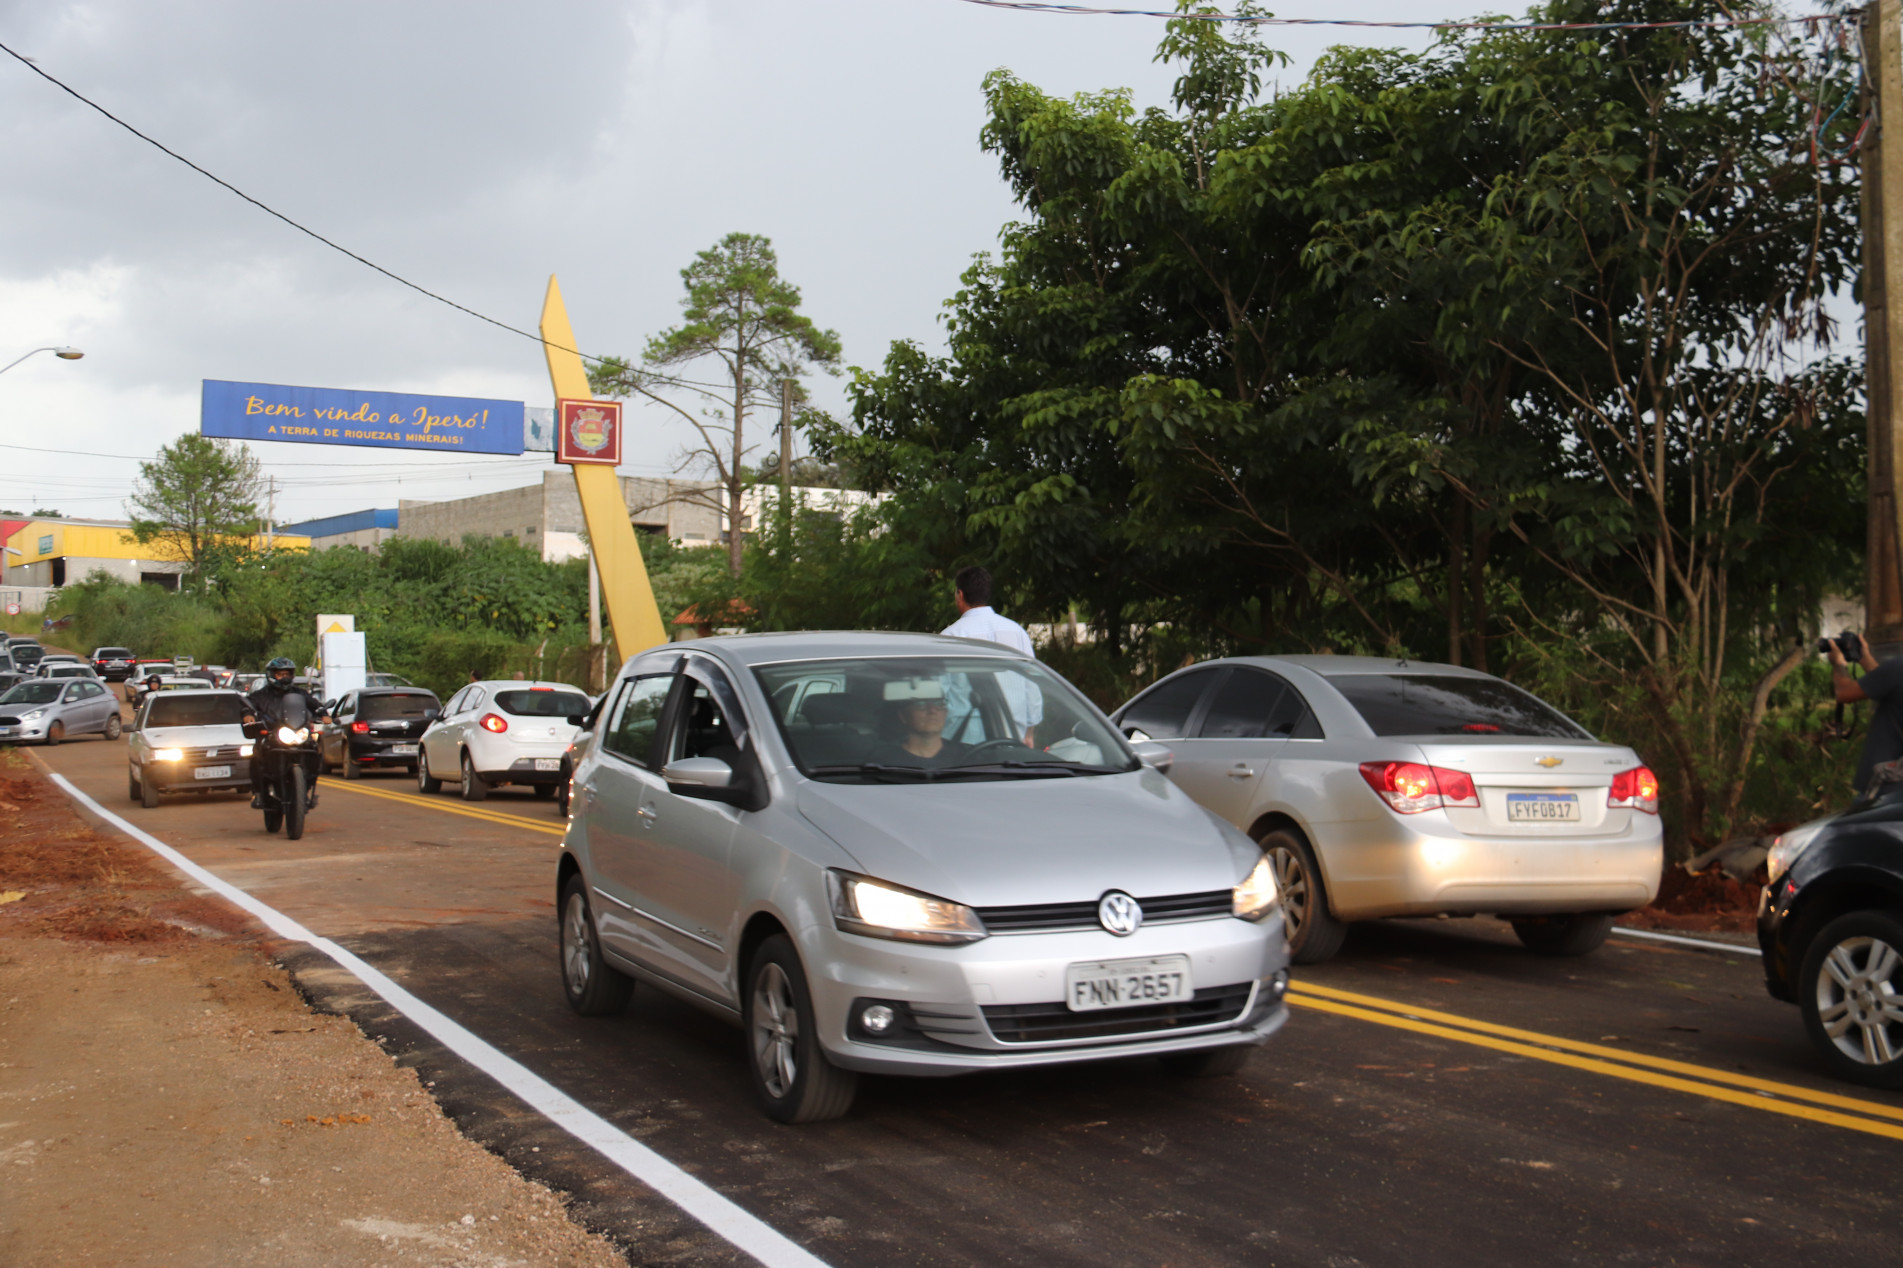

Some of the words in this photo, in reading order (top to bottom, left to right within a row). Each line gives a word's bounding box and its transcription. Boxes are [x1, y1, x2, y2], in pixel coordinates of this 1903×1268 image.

[245, 395, 306, 418] Bem
[313, 402, 380, 423] vindo
[388, 413, 406, 424] a
[411, 406, 489, 434] Iperó!
[268, 425, 277, 434] A
[280, 425, 318, 436] TERRA
[323, 428, 339, 437] DE
[344, 429, 400, 441] RIQUEZAS
[405, 433, 463, 444] MINERAIS!
